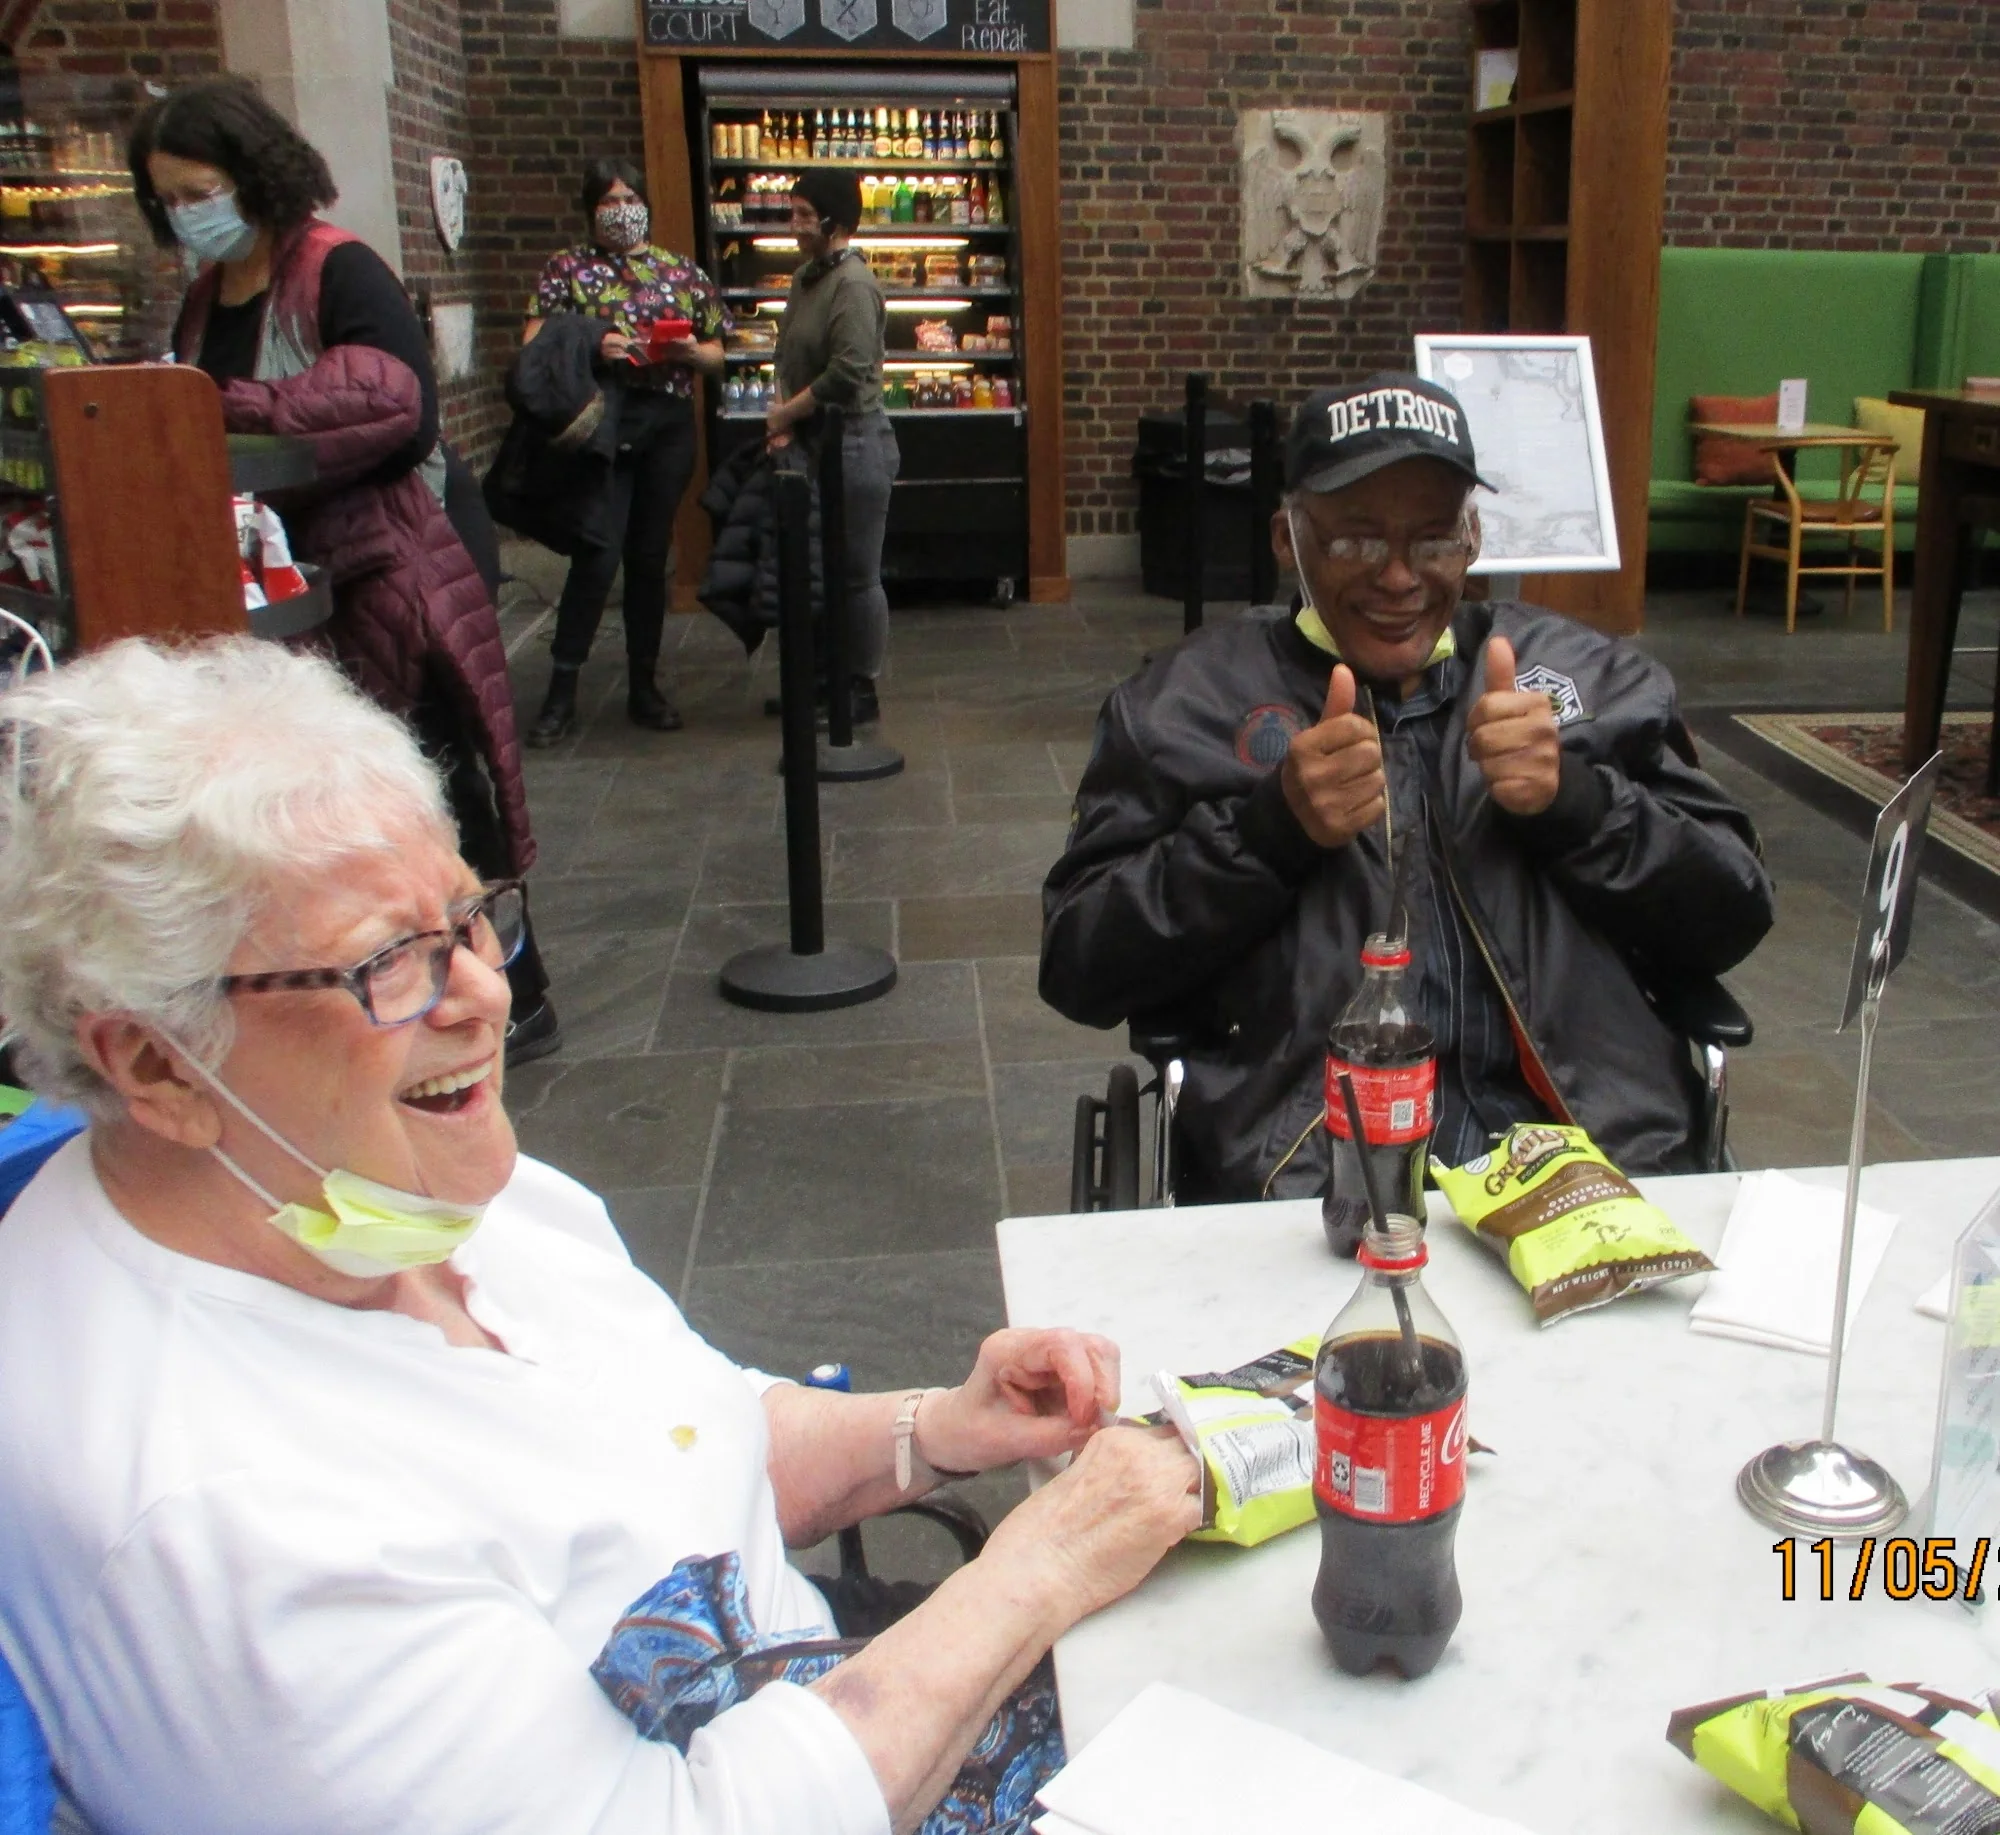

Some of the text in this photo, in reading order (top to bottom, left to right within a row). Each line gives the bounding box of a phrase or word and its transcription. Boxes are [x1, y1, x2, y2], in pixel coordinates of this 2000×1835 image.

[649, 11, 742, 41] COURT
[1327, 388, 1459, 445] DETROIT
[1538, 1187, 1628, 1221] POTATO CHIPS
[1549, 1181, 1610, 1208] ORIGINAL
[1552, 1280, 1569, 1295] NET
[1571, 1267, 1609, 1286] WEIGHT
[1419, 1420, 1432, 1509] RECYCLE ME
